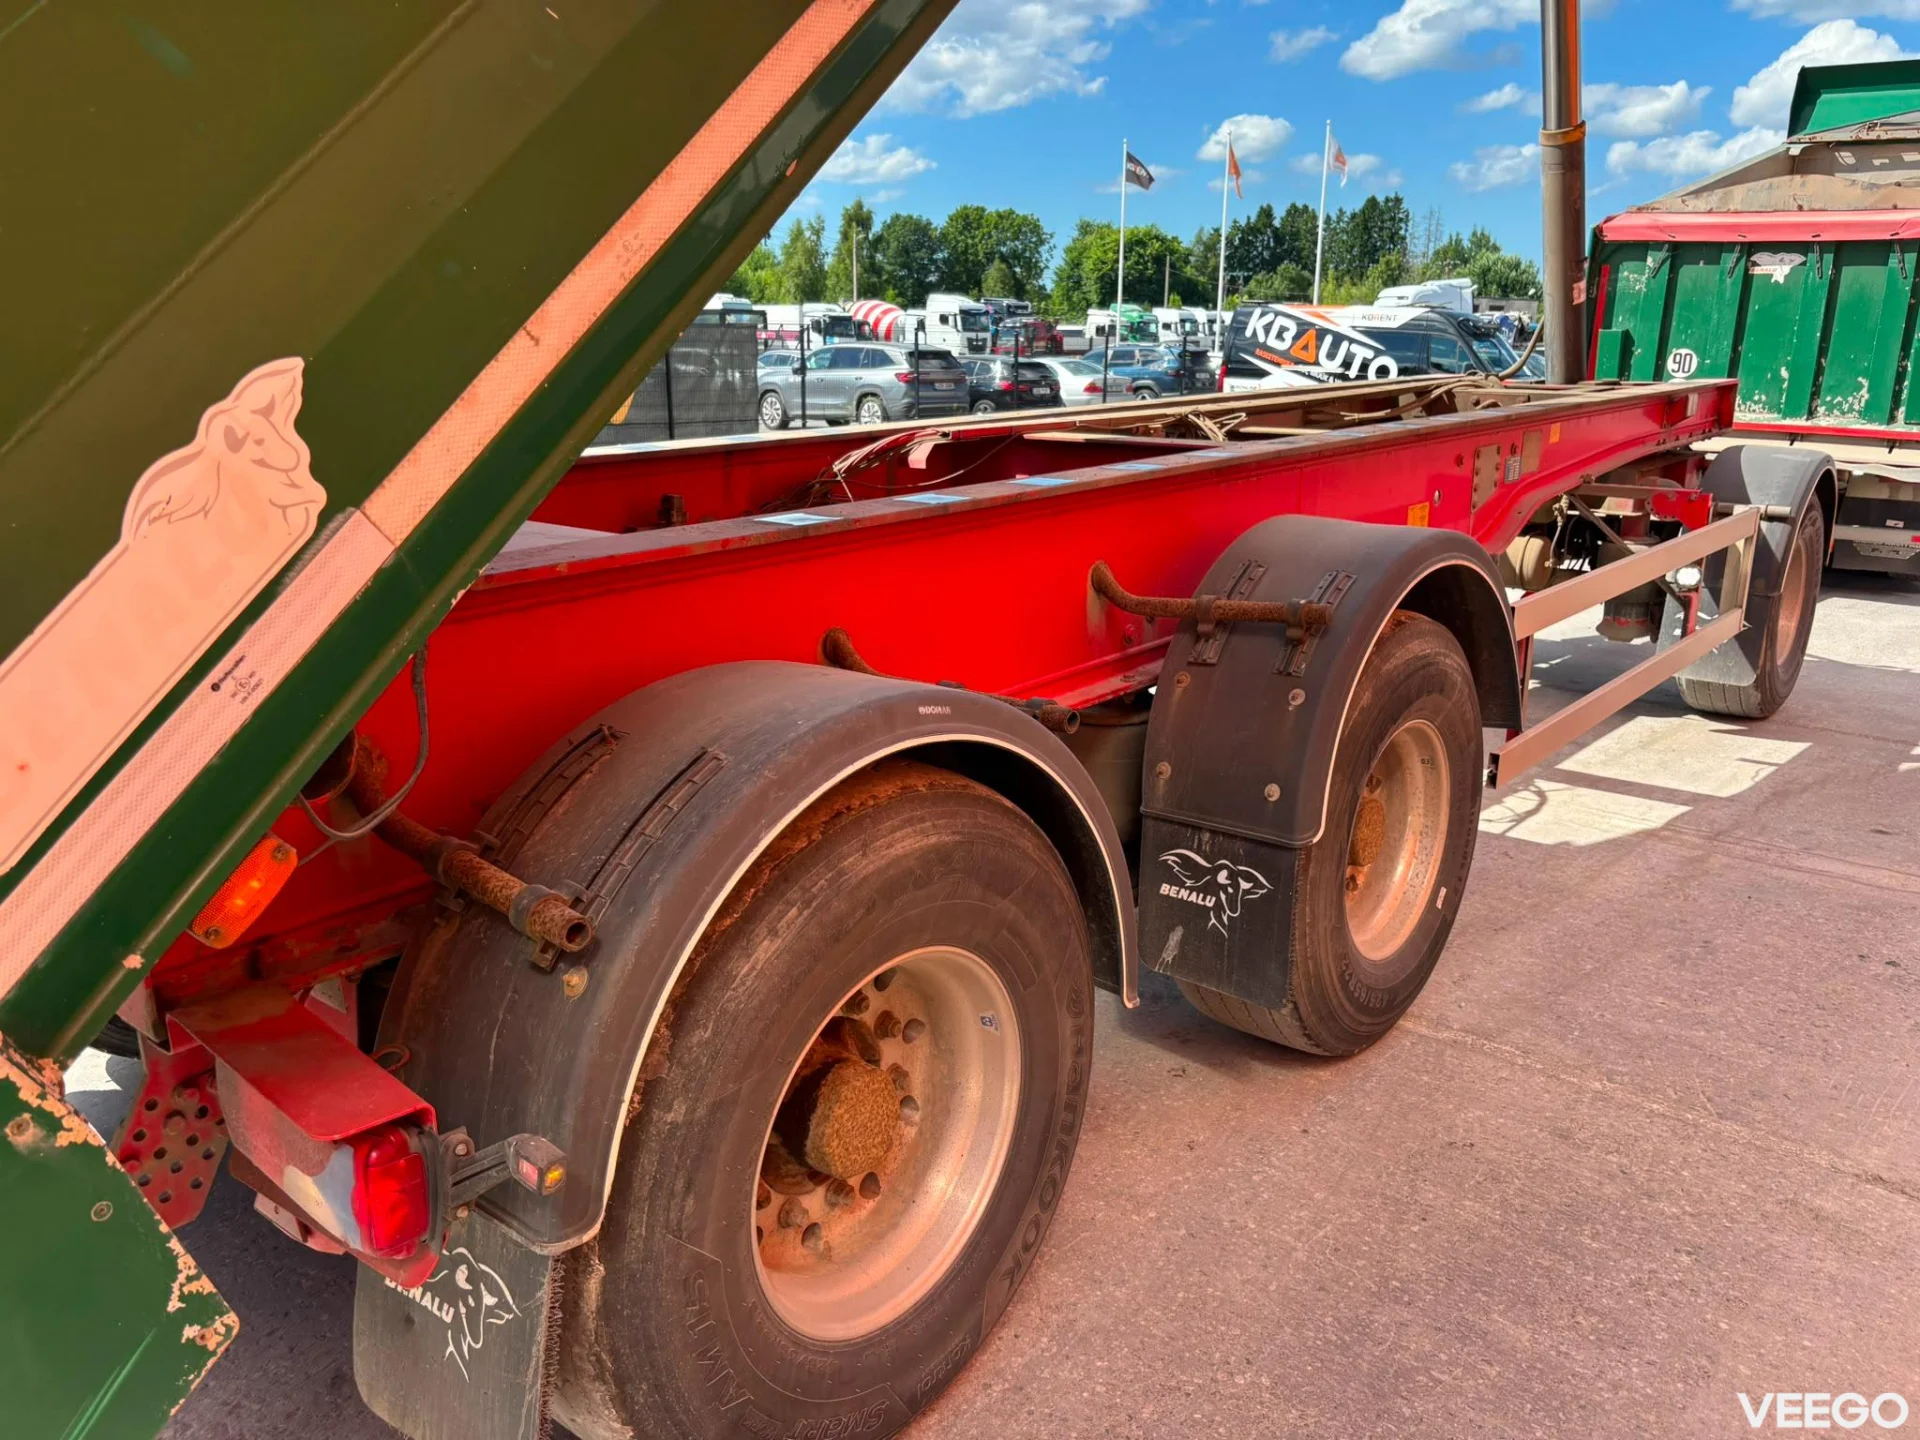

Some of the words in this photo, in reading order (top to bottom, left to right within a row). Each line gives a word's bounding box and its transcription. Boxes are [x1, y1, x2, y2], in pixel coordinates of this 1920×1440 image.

[1245, 307, 1398, 380] KBAUTO
[1672, 353, 1693, 373] 90
[1159, 883, 1217, 908] BENALU
[384, 1276, 455, 1324] NALU
